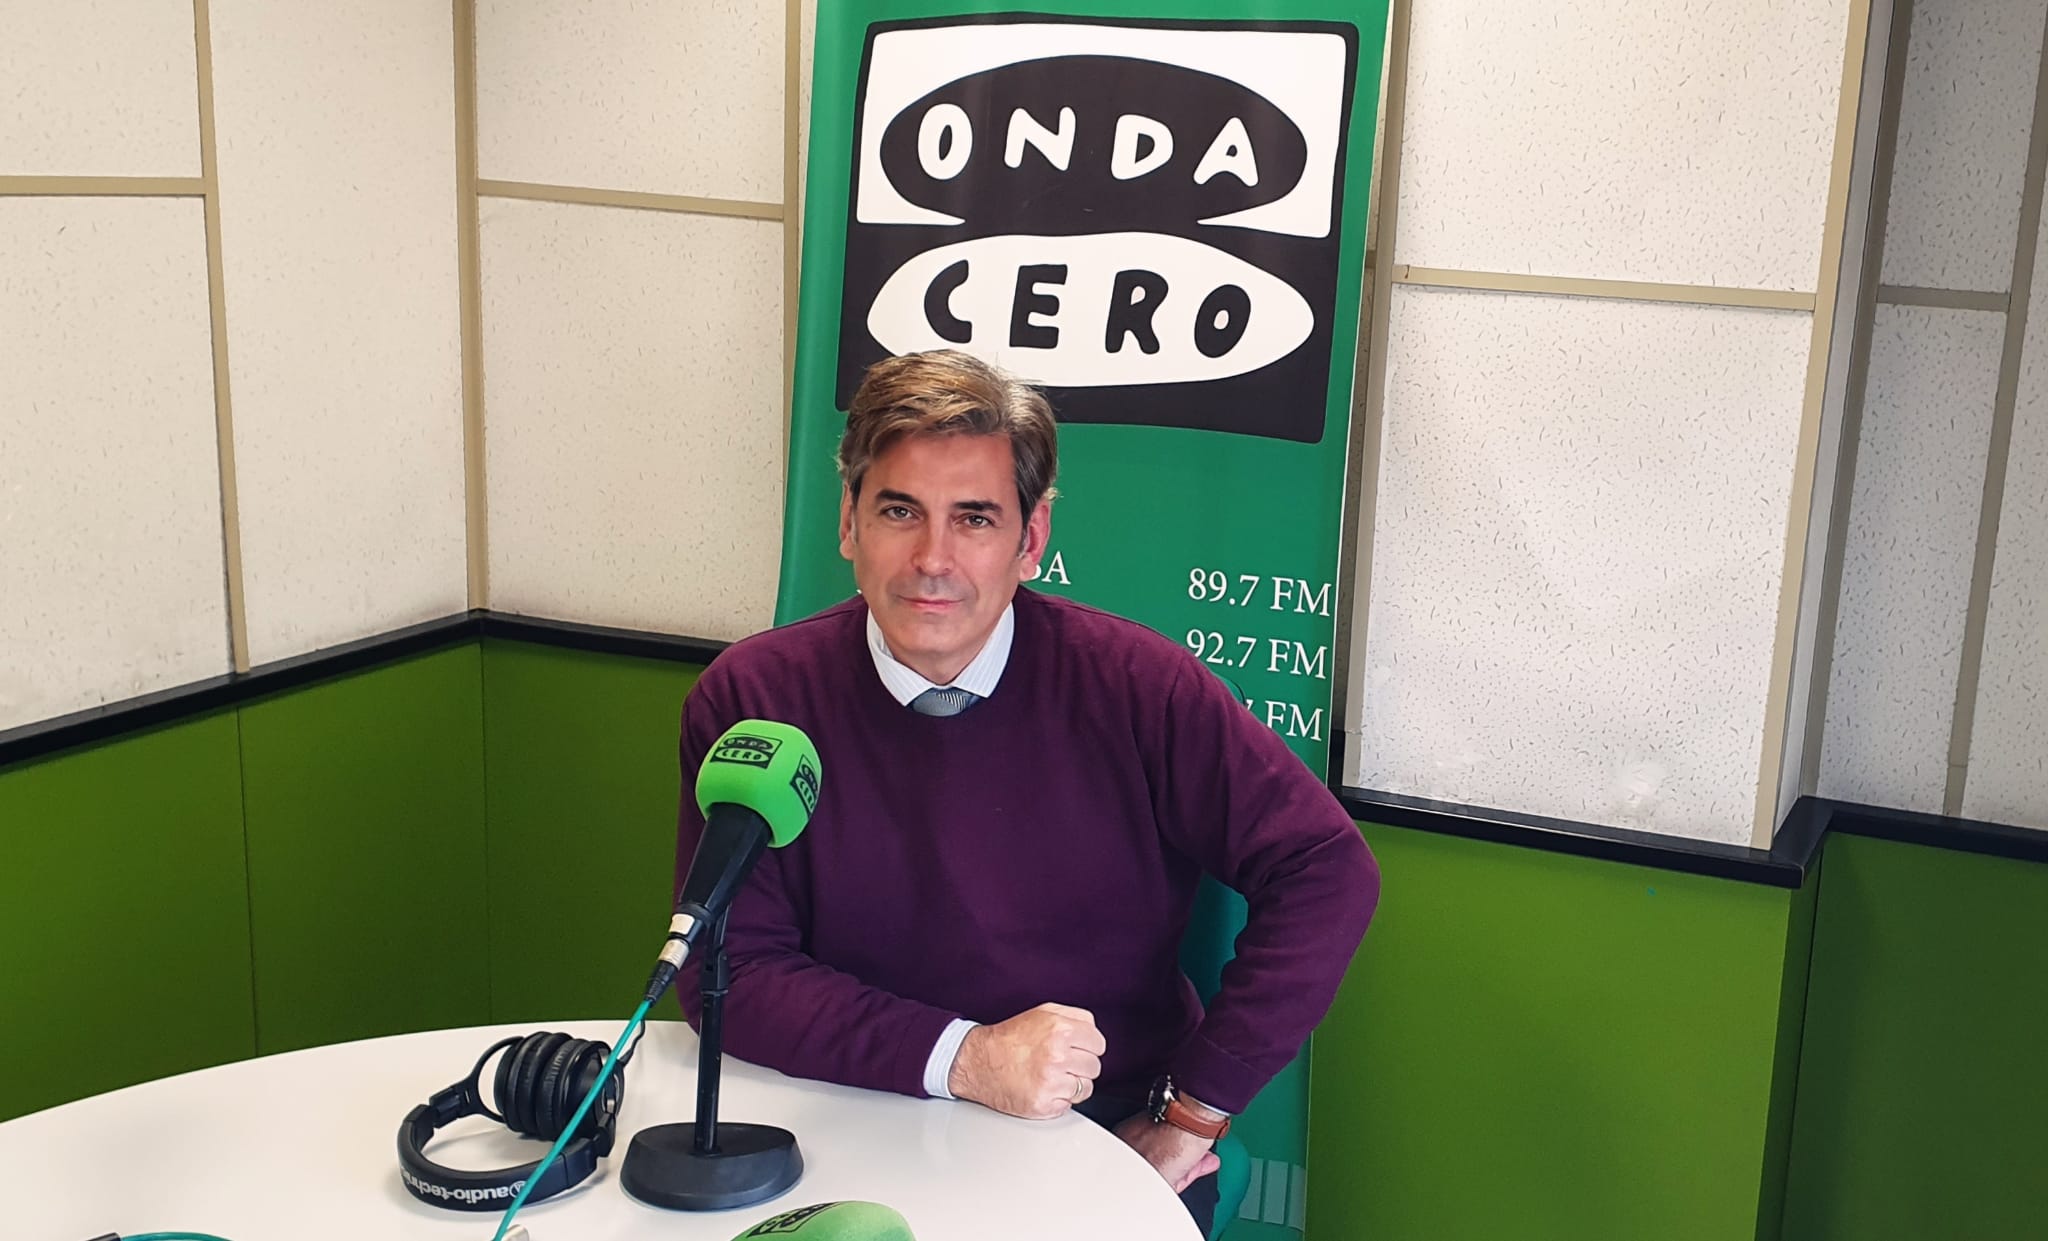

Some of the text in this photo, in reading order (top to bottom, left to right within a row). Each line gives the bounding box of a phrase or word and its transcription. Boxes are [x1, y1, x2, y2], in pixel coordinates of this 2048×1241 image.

[917, 103, 1259, 187] ONDA
[924, 259, 1252, 359] CERO
[1188, 568, 1332, 617] 89.7 FM
[1186, 629, 1328, 679] 92.7 FM
[727, 738, 770, 749] ONDA
[1265, 700, 1324, 741] FM
[722, 749, 762, 761] CERO
